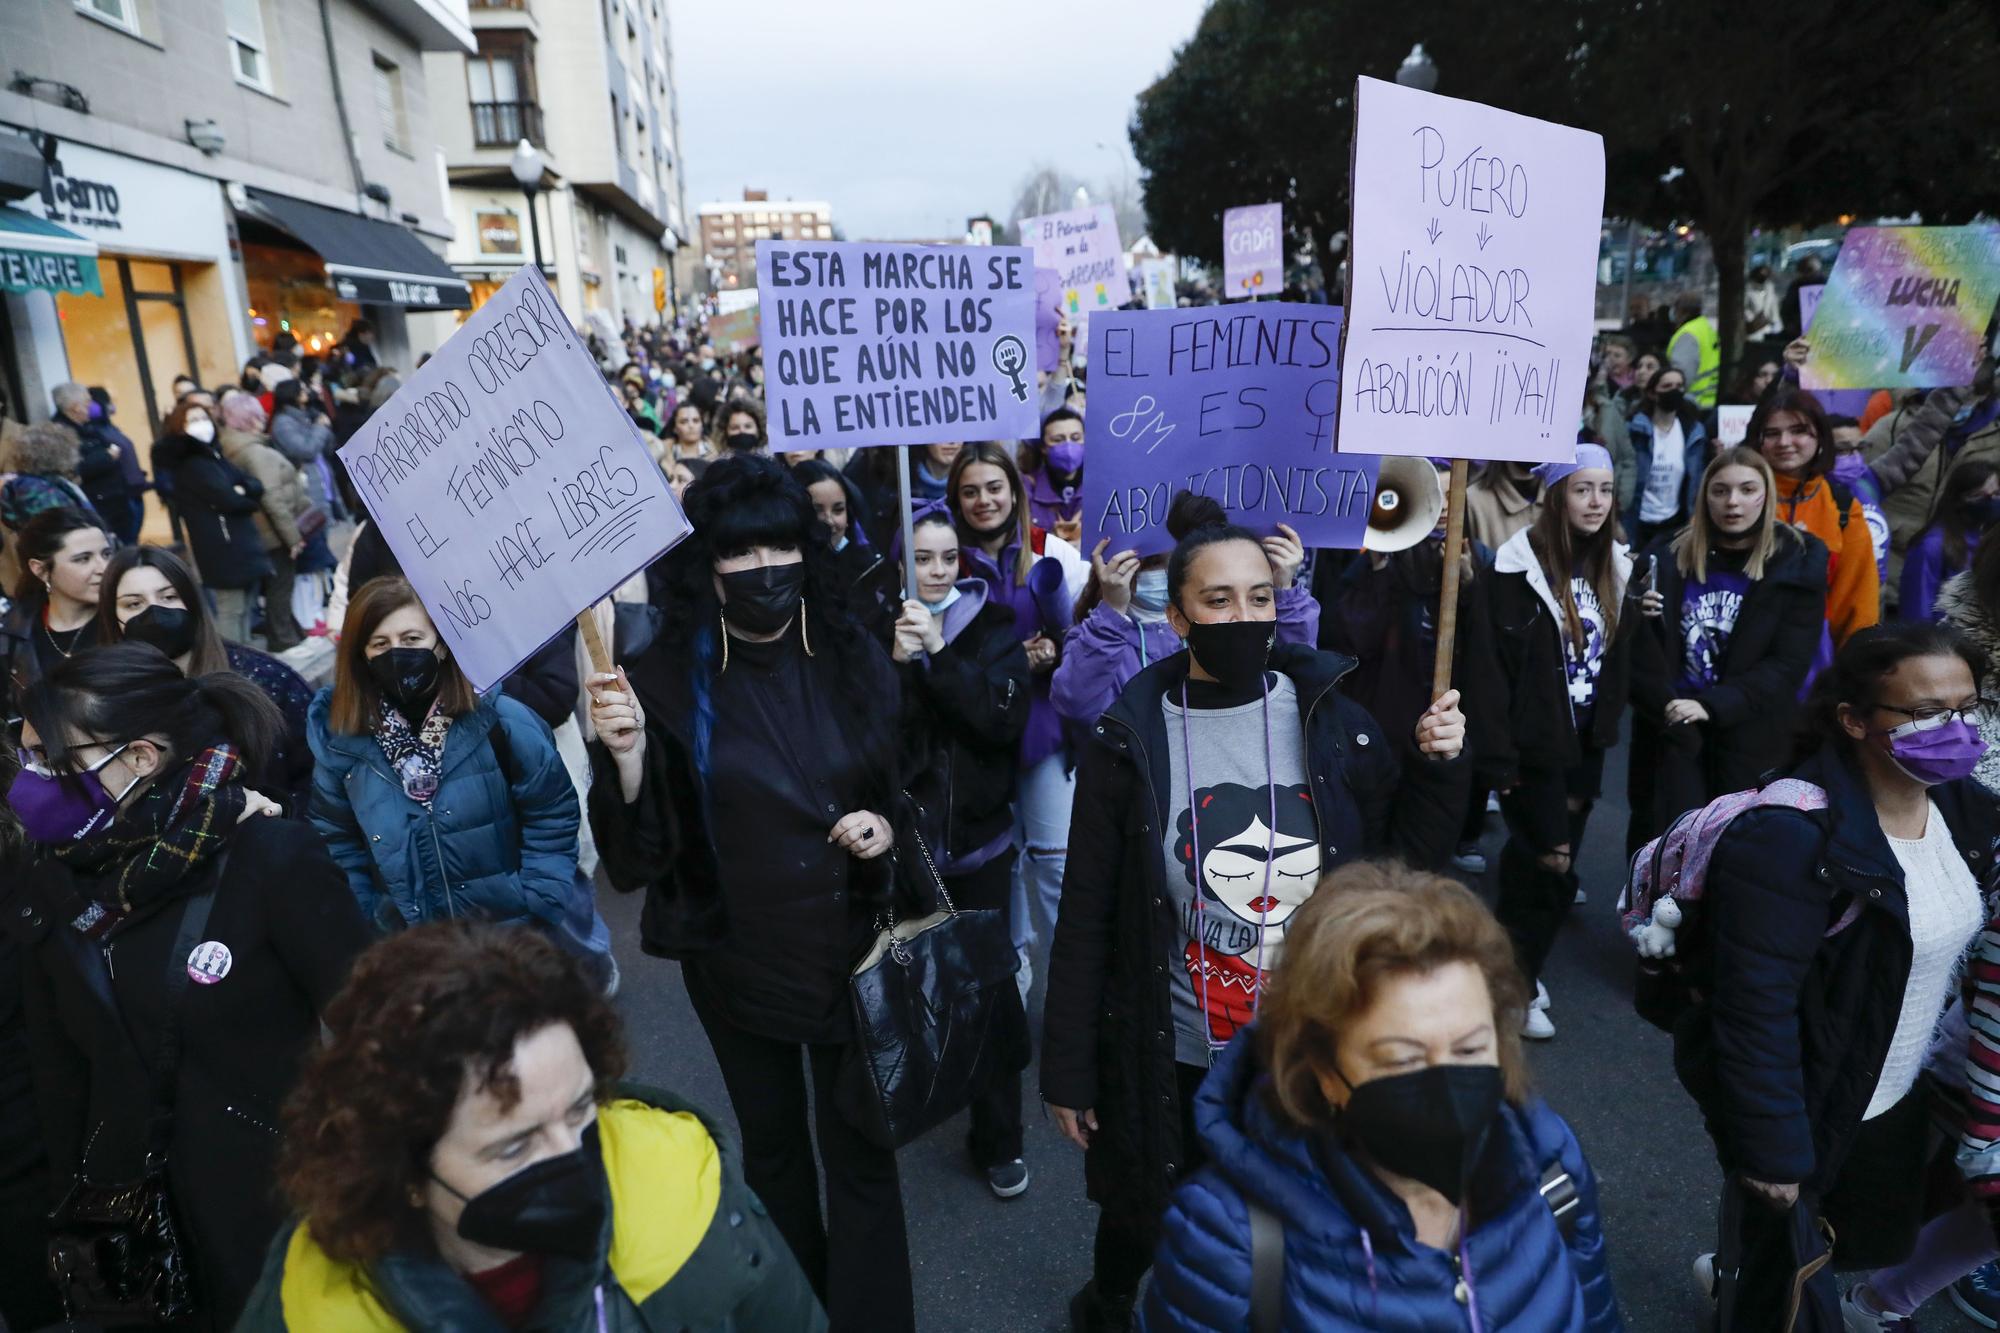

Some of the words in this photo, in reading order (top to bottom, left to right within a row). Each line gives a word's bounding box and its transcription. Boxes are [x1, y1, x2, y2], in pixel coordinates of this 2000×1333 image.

[1413, 126, 1528, 218] PUTERO
[1230, 226, 1276, 256] CADA
[771, 251, 845, 287] ESTA
[863, 252, 973, 291] MARCHA
[988, 255, 1023, 291] SE
[1379, 249, 1533, 328] VIOLADOR
[467, 277, 572, 395] OPRESOR!
[777, 297, 858, 337] HACE
[875, 297, 928, 335] POR
[944, 297, 992, 333] LOS
[778, 346, 841, 386] QUE
[857, 335, 922, 384] AÚN
[935, 341, 976, 380] NO
[1105, 328, 1149, 377] EL
[1169, 315, 1342, 376] FEMINIS
[782, 398, 821, 436] LA
[834, 384, 997, 432] ENTIENDEN
[1200, 387, 1268, 437] ES
[1355, 352, 1472, 418] ABOLICIÓN
[406, 512, 450, 560] EL
[446, 399, 565, 518] FEMINISMO
[439, 578, 493, 641] NOS
[488, 518, 556, 592] HACE
[547, 445, 638, 540] LIBRES
[1183, 901, 1223, 949] VIVA
[1228, 921, 1252, 949] LA
